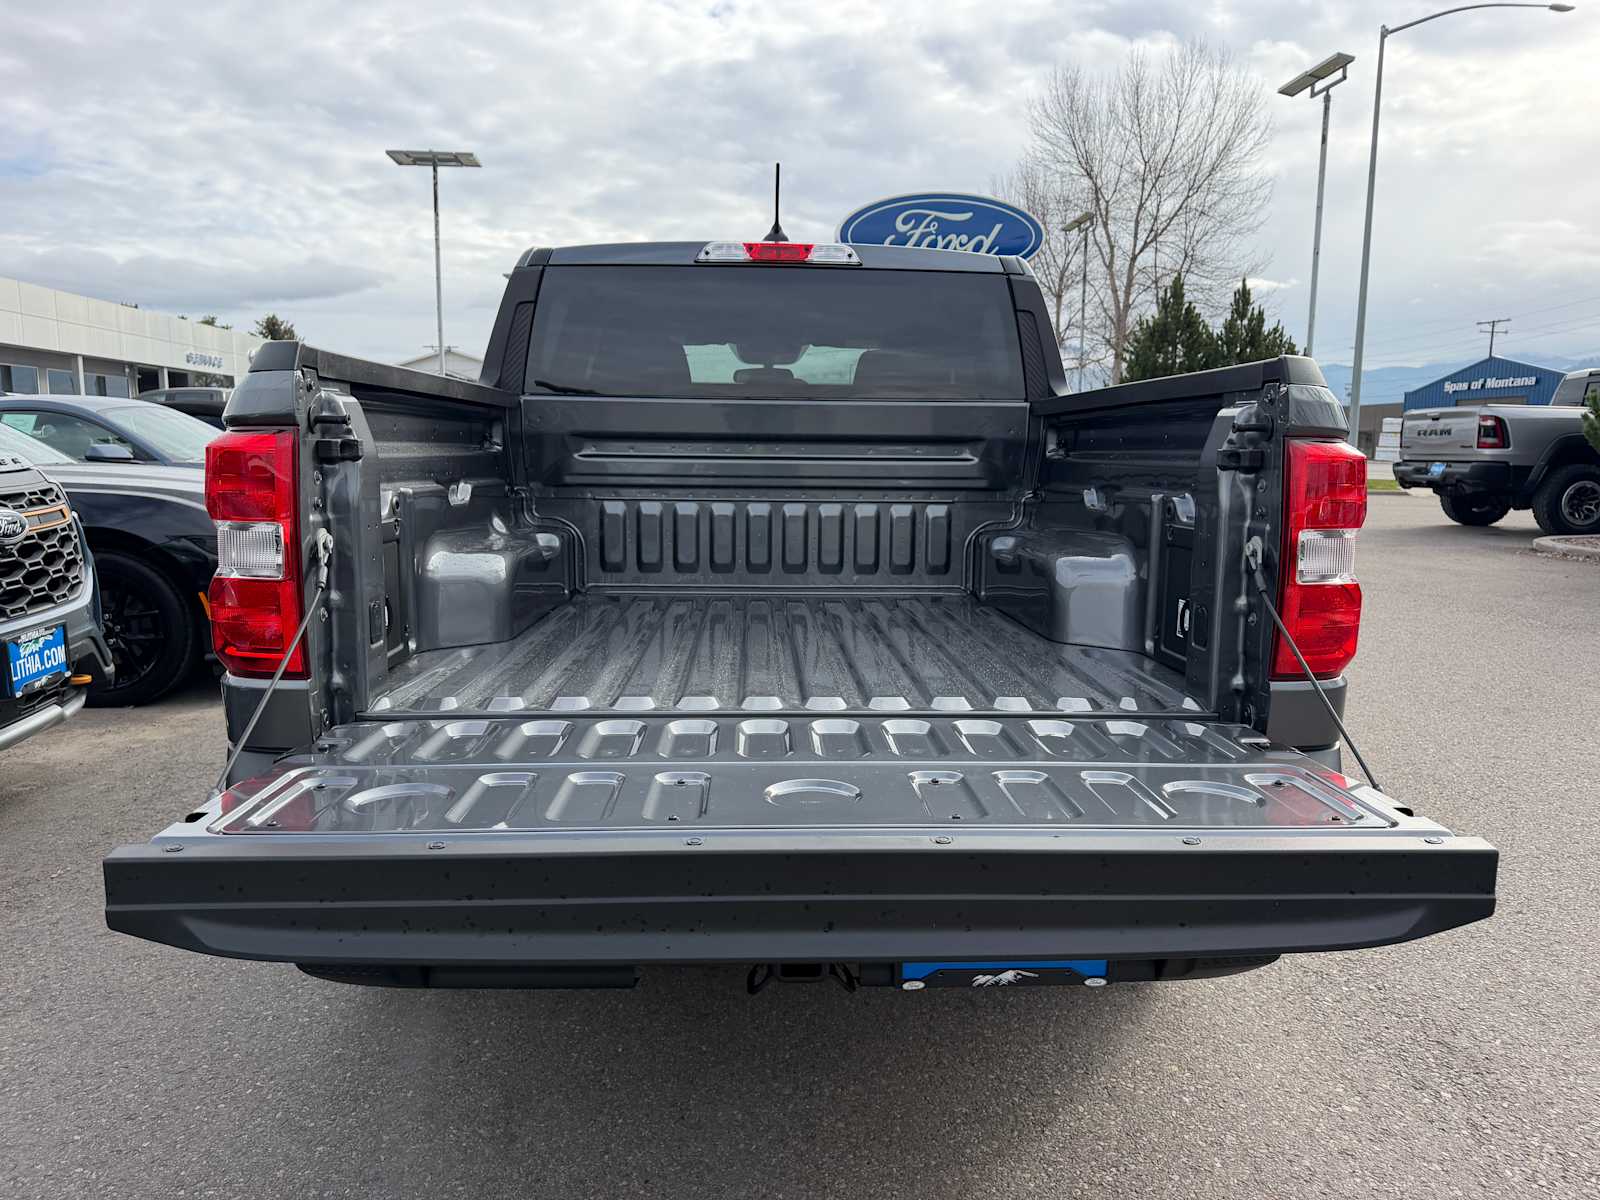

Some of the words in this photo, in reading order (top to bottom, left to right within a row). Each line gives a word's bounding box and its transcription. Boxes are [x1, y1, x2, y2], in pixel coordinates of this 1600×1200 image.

[884, 209, 1003, 255] Ford
[186, 352, 223, 368] SERVICE
[1444, 381, 1469, 394] Spas
[1470, 378, 1484, 389] of
[1485, 376, 1536, 389] Montana
[1417, 428, 1452, 436] RAM
[10, 644, 66, 681] LITHIA.COM
